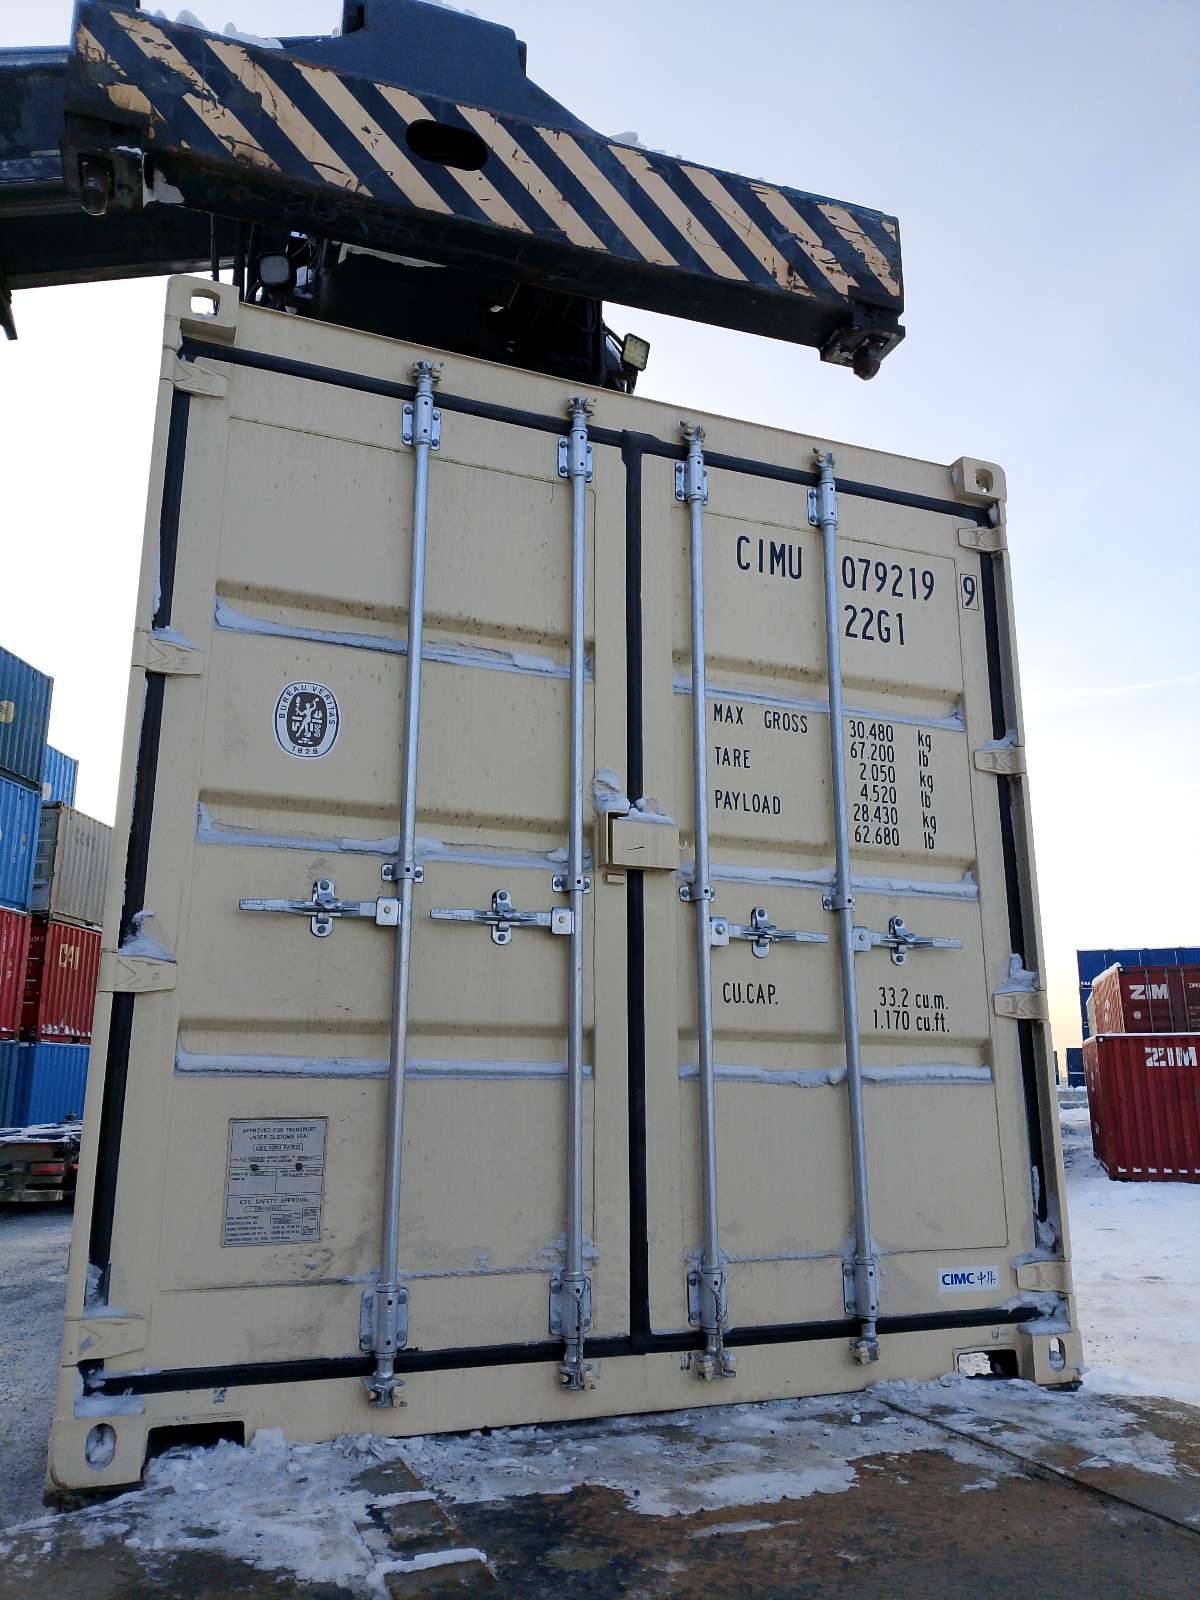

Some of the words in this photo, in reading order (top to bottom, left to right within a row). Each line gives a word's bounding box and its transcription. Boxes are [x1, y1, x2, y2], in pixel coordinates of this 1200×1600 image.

[736, 535, 802, 580] CIMU
[842, 555, 935, 601] 079219
[962, 576, 977, 608] 9
[844, 604, 905, 646] 22G1
[278, 684, 307, 719] BUREAU
[312, 685, 336, 726] VERITAS
[713, 703, 744, 726] MAX
[764, 710, 808, 734] GROSS
[849, 719, 894, 743] 30.480
[917, 730, 932, 753] kg
[291, 745, 319, 755] 1828
[850, 741, 895, 764] 67.200
[918, 750, 929, 768] lb
[714, 746, 751, 769] TARE
[859, 762, 896, 784] 2.050
[919, 770, 934, 793] kg
[860, 783, 897, 805] 4.520
[920, 790, 931, 809] lb
[714, 789, 781, 815] PAYLOAD
[853, 803, 898, 826] 28.430
[922, 811, 937, 834] kg
[854, 825, 900, 847] 62.680
[923, 831, 935, 850] lb
[722, 982, 779, 1005] CU.CAP.
[878, 986, 910, 1008] 33.2
[915, 991, 949, 1010] cu.m.
[1128, 983, 1169, 1000] ZIM
[873, 1009, 910, 1031] 1.170
[916, 1012, 950, 1033] cu.ft.
[1144, 1046, 1198, 1067] ZIM
[941, 1272, 976, 1286] CIMC
